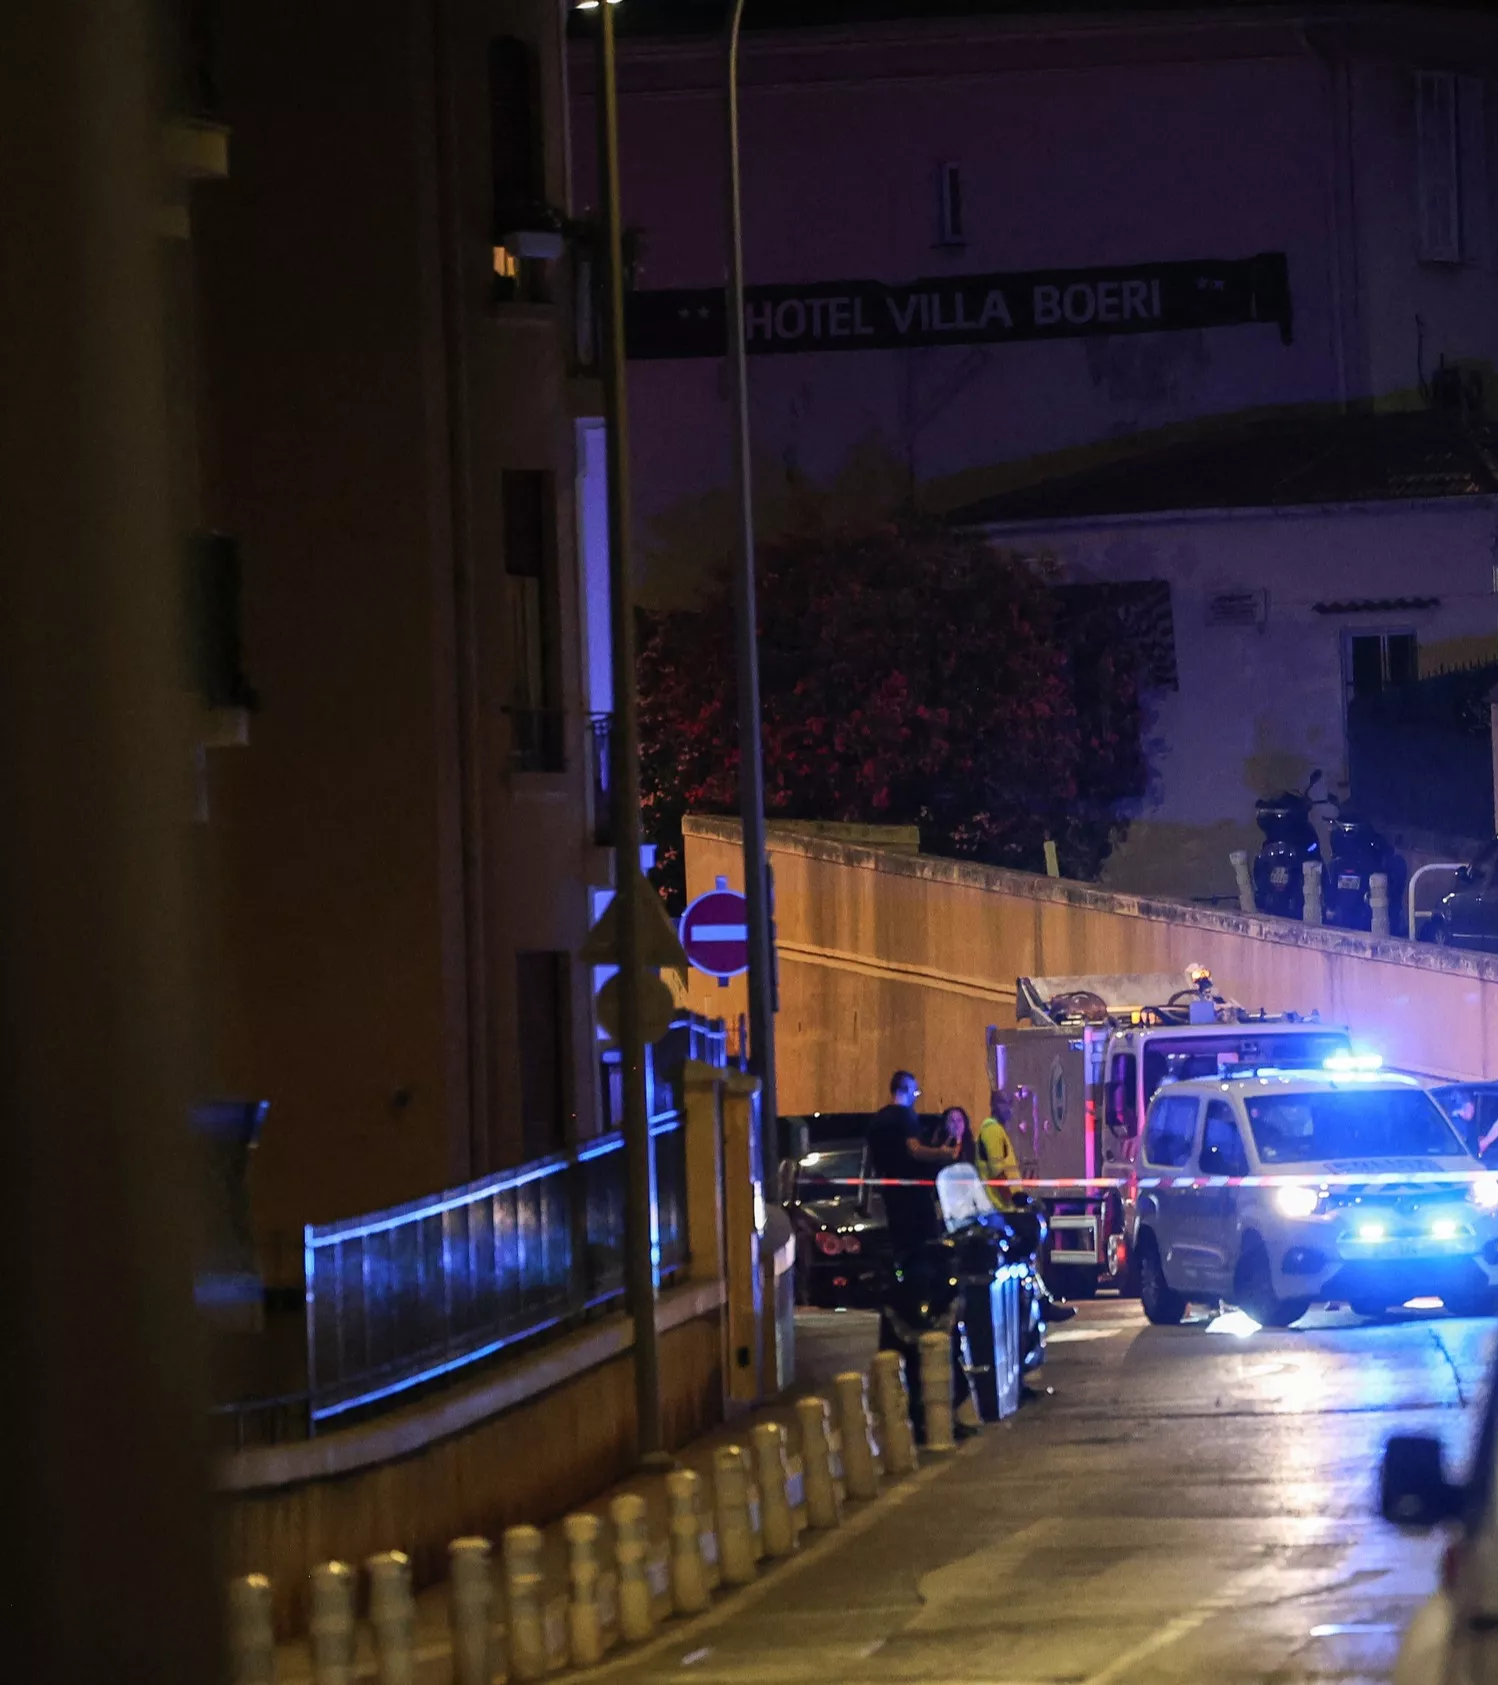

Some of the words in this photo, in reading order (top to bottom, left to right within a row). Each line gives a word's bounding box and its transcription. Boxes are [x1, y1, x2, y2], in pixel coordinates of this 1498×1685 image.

[746, 296, 875, 341] HOTEL
[886, 287, 1013, 334] VILLA
[1032, 278, 1162, 326] BOERI
